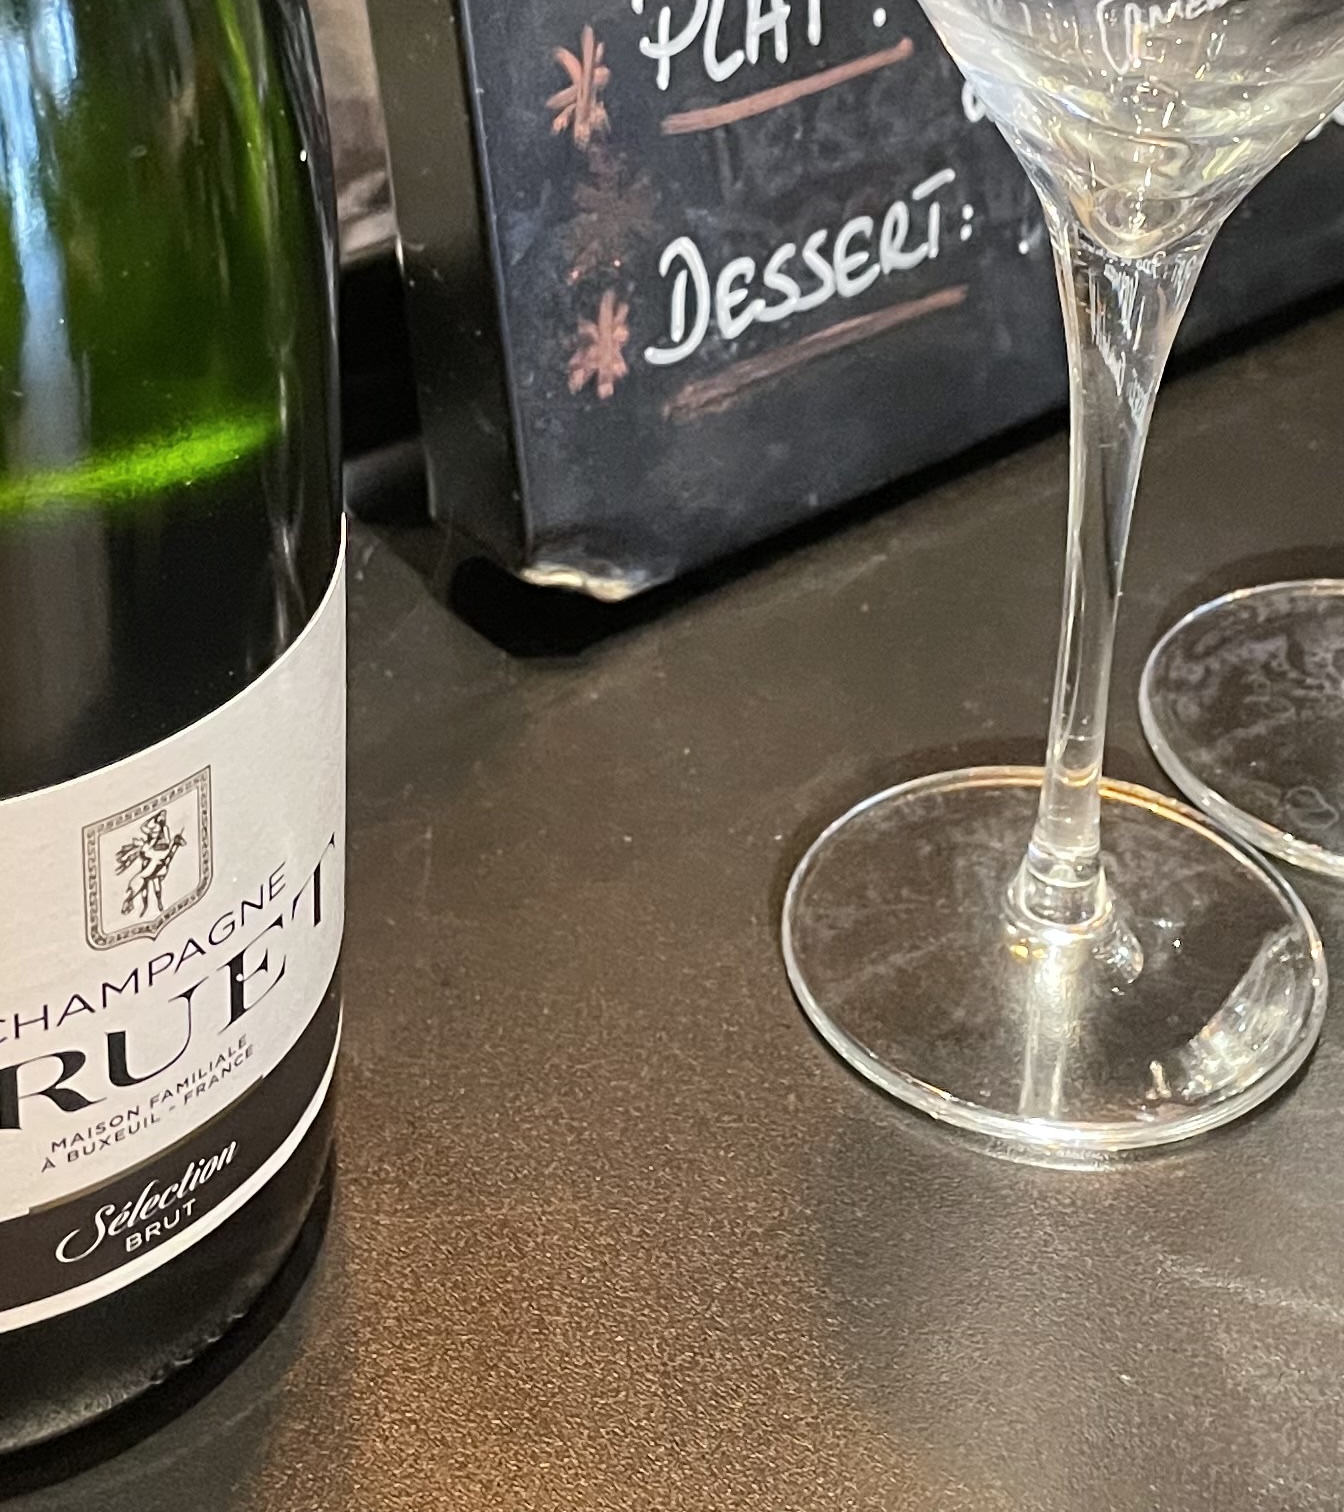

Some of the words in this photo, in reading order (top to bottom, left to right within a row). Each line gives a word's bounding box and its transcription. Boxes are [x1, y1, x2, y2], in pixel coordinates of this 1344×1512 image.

[50, 1104, 141, 1153] MAISON
[148, 1033, 248, 1110] FAMILIALE
[66, 1111, 162, 1164] BUXEUIL
[183, 1043, 255, 1106] FRANCE
[55, 1140, 240, 1264] Sélection
[124, 1197, 198, 1254] BRUT
